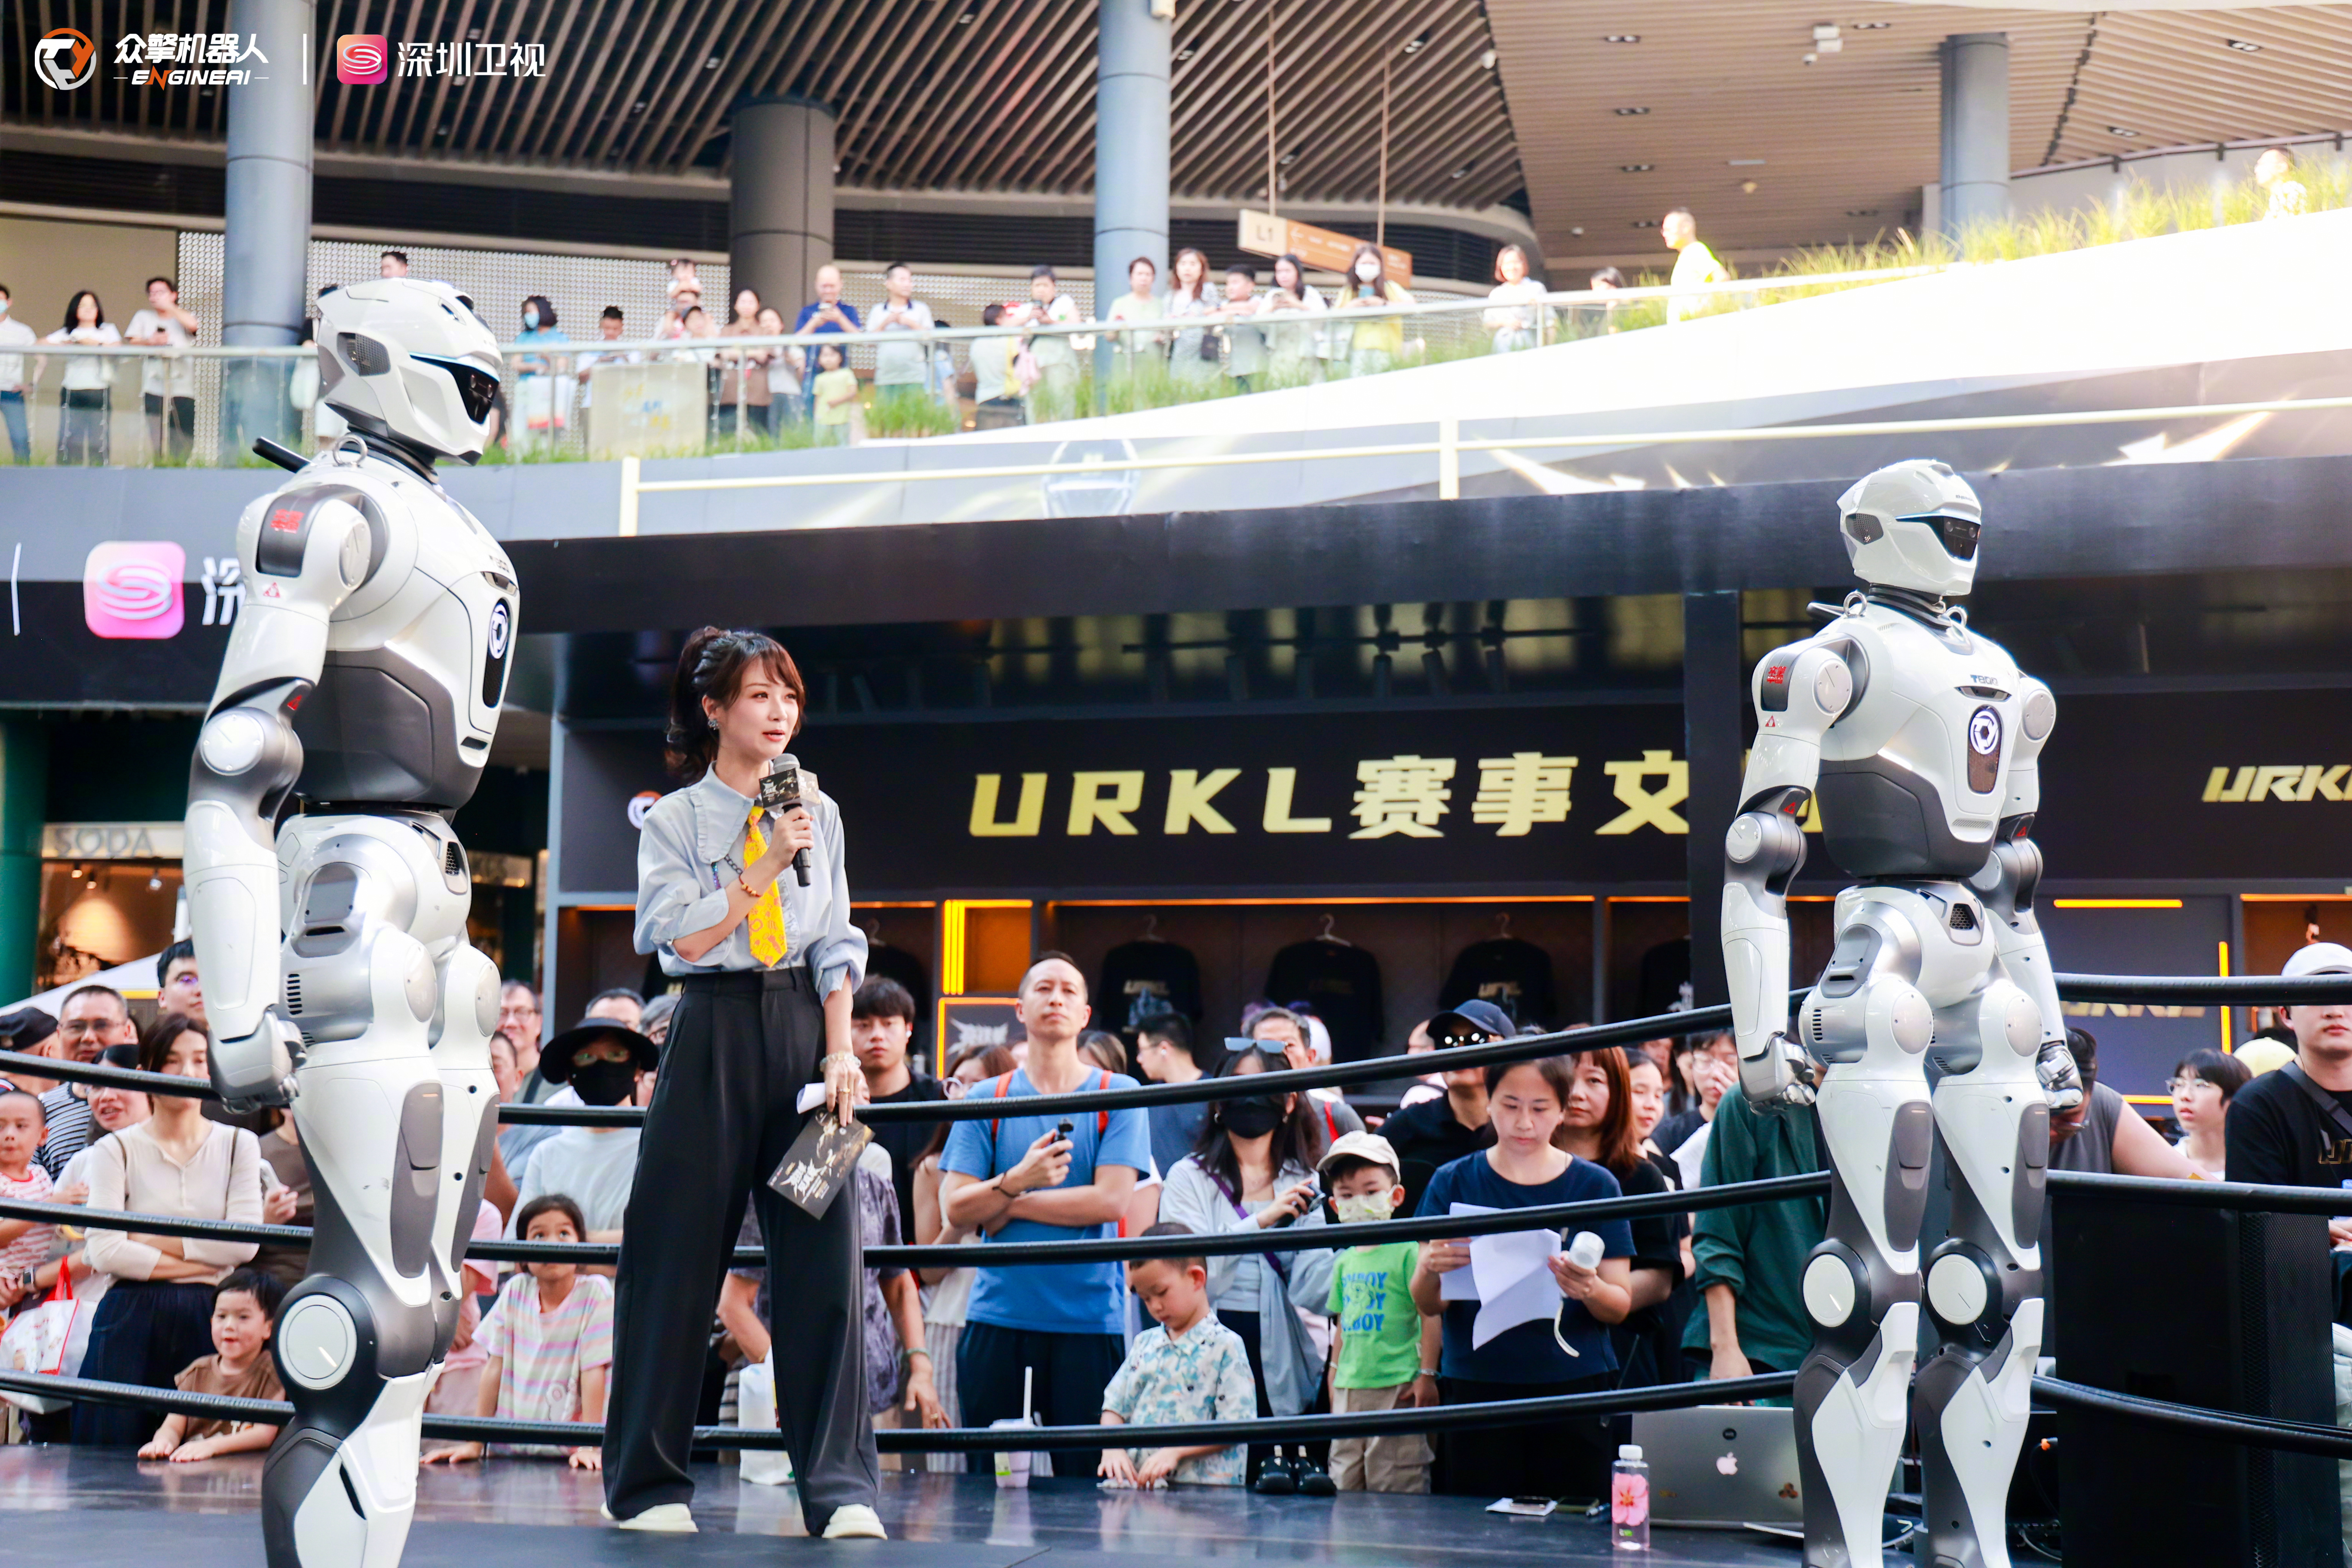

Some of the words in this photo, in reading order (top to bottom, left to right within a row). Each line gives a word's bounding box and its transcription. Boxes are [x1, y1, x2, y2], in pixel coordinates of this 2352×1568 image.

[969, 767, 1331, 837] URKL
[1348, 750, 1822, 840] 赛事文
[2201, 764, 2352, 802] URK
[55, 827, 153, 858] SODA
